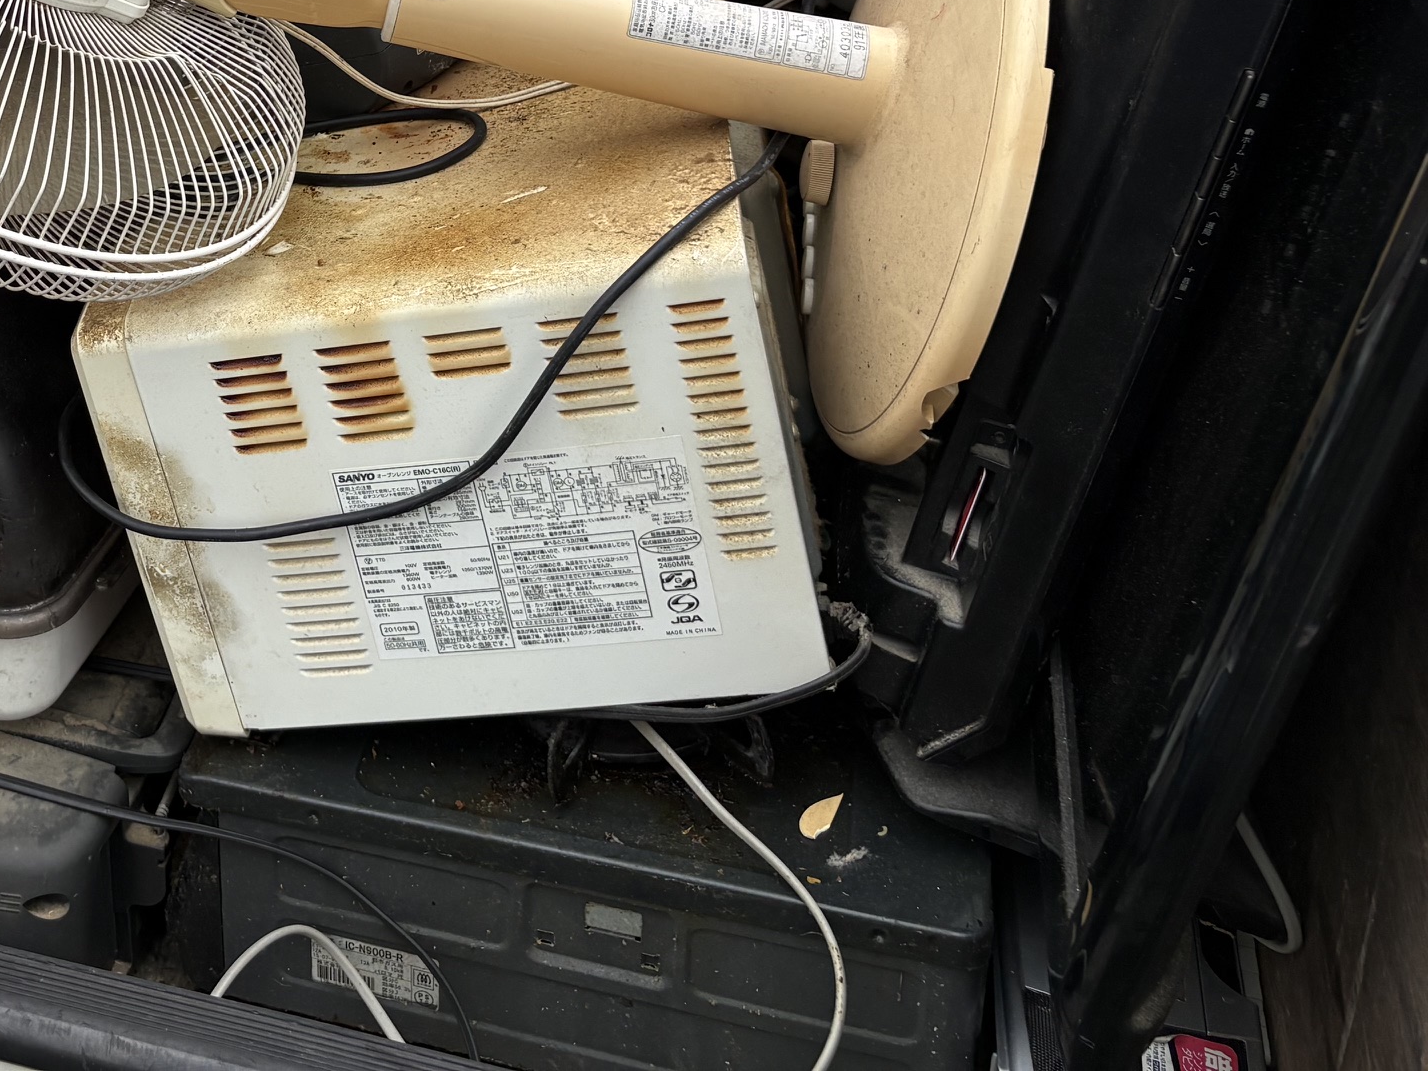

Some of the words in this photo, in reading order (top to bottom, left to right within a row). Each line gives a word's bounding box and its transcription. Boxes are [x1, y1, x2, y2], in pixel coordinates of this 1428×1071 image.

[337, 472, 375, 483] SANYO
[400, 581, 432, 591] 013433
[671, 614, 704, 625] JQA
[383, 624, 416, 633] 2010年製
